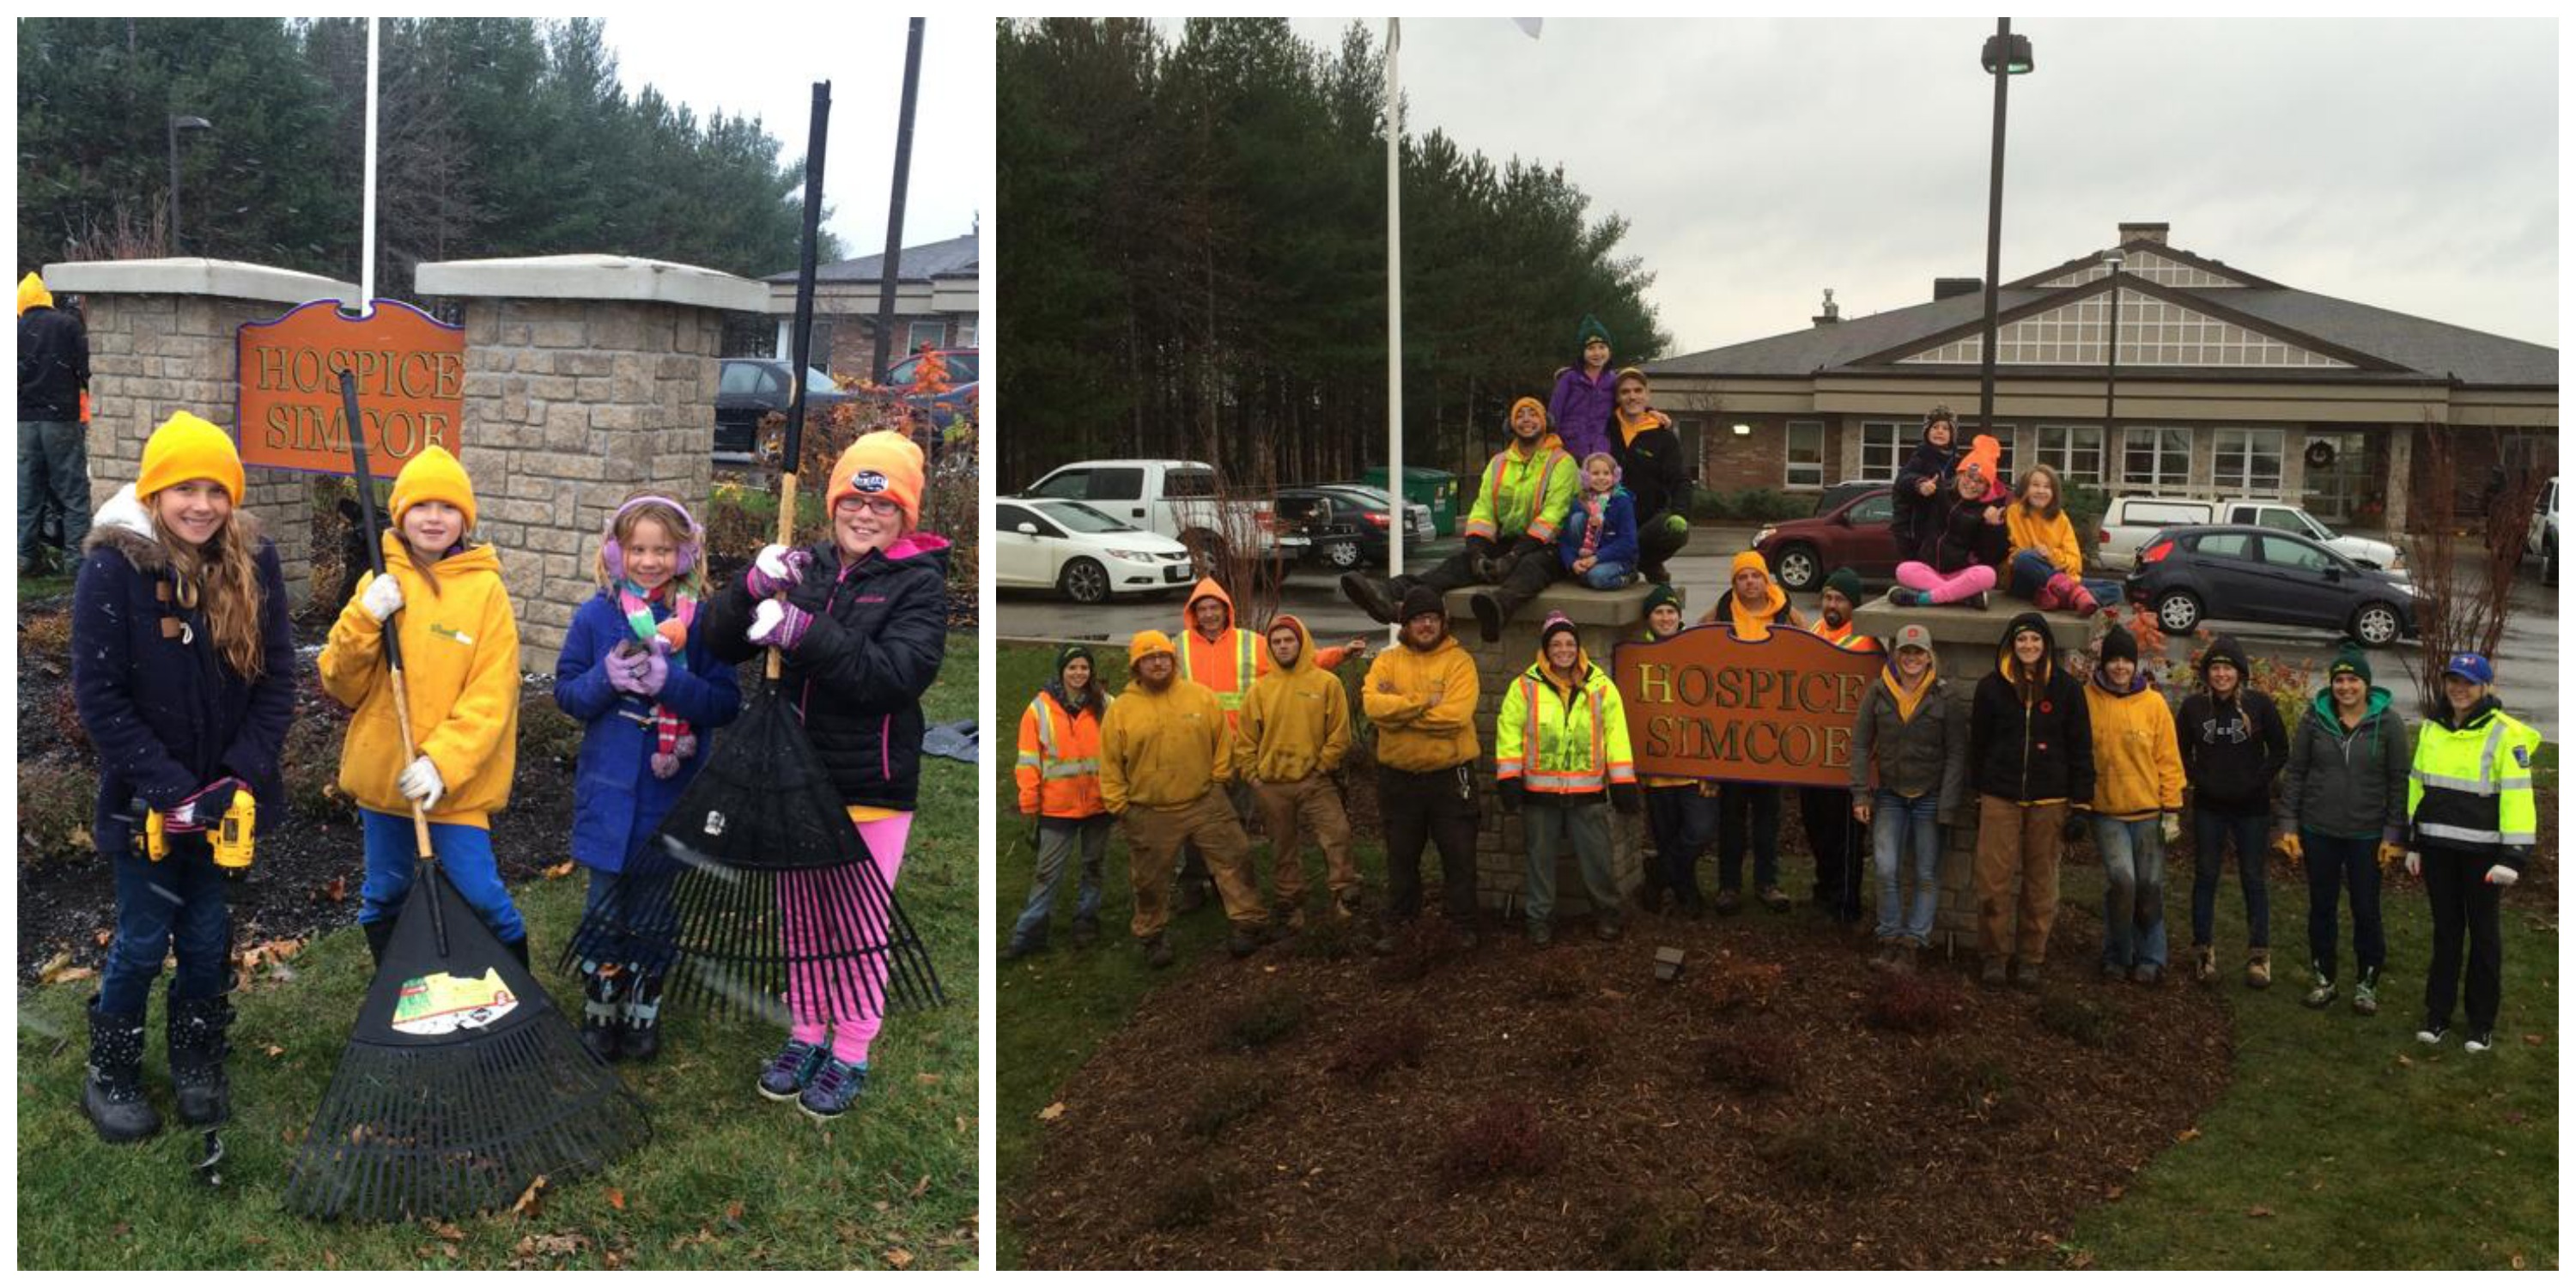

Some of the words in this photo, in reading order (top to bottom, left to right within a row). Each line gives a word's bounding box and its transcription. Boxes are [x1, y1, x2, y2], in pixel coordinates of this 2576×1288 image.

[257, 346, 463, 400] HOSPICE
[1636, 663, 1866, 714] HOSPICE
[1646, 715, 1851, 768] SIMCOE
